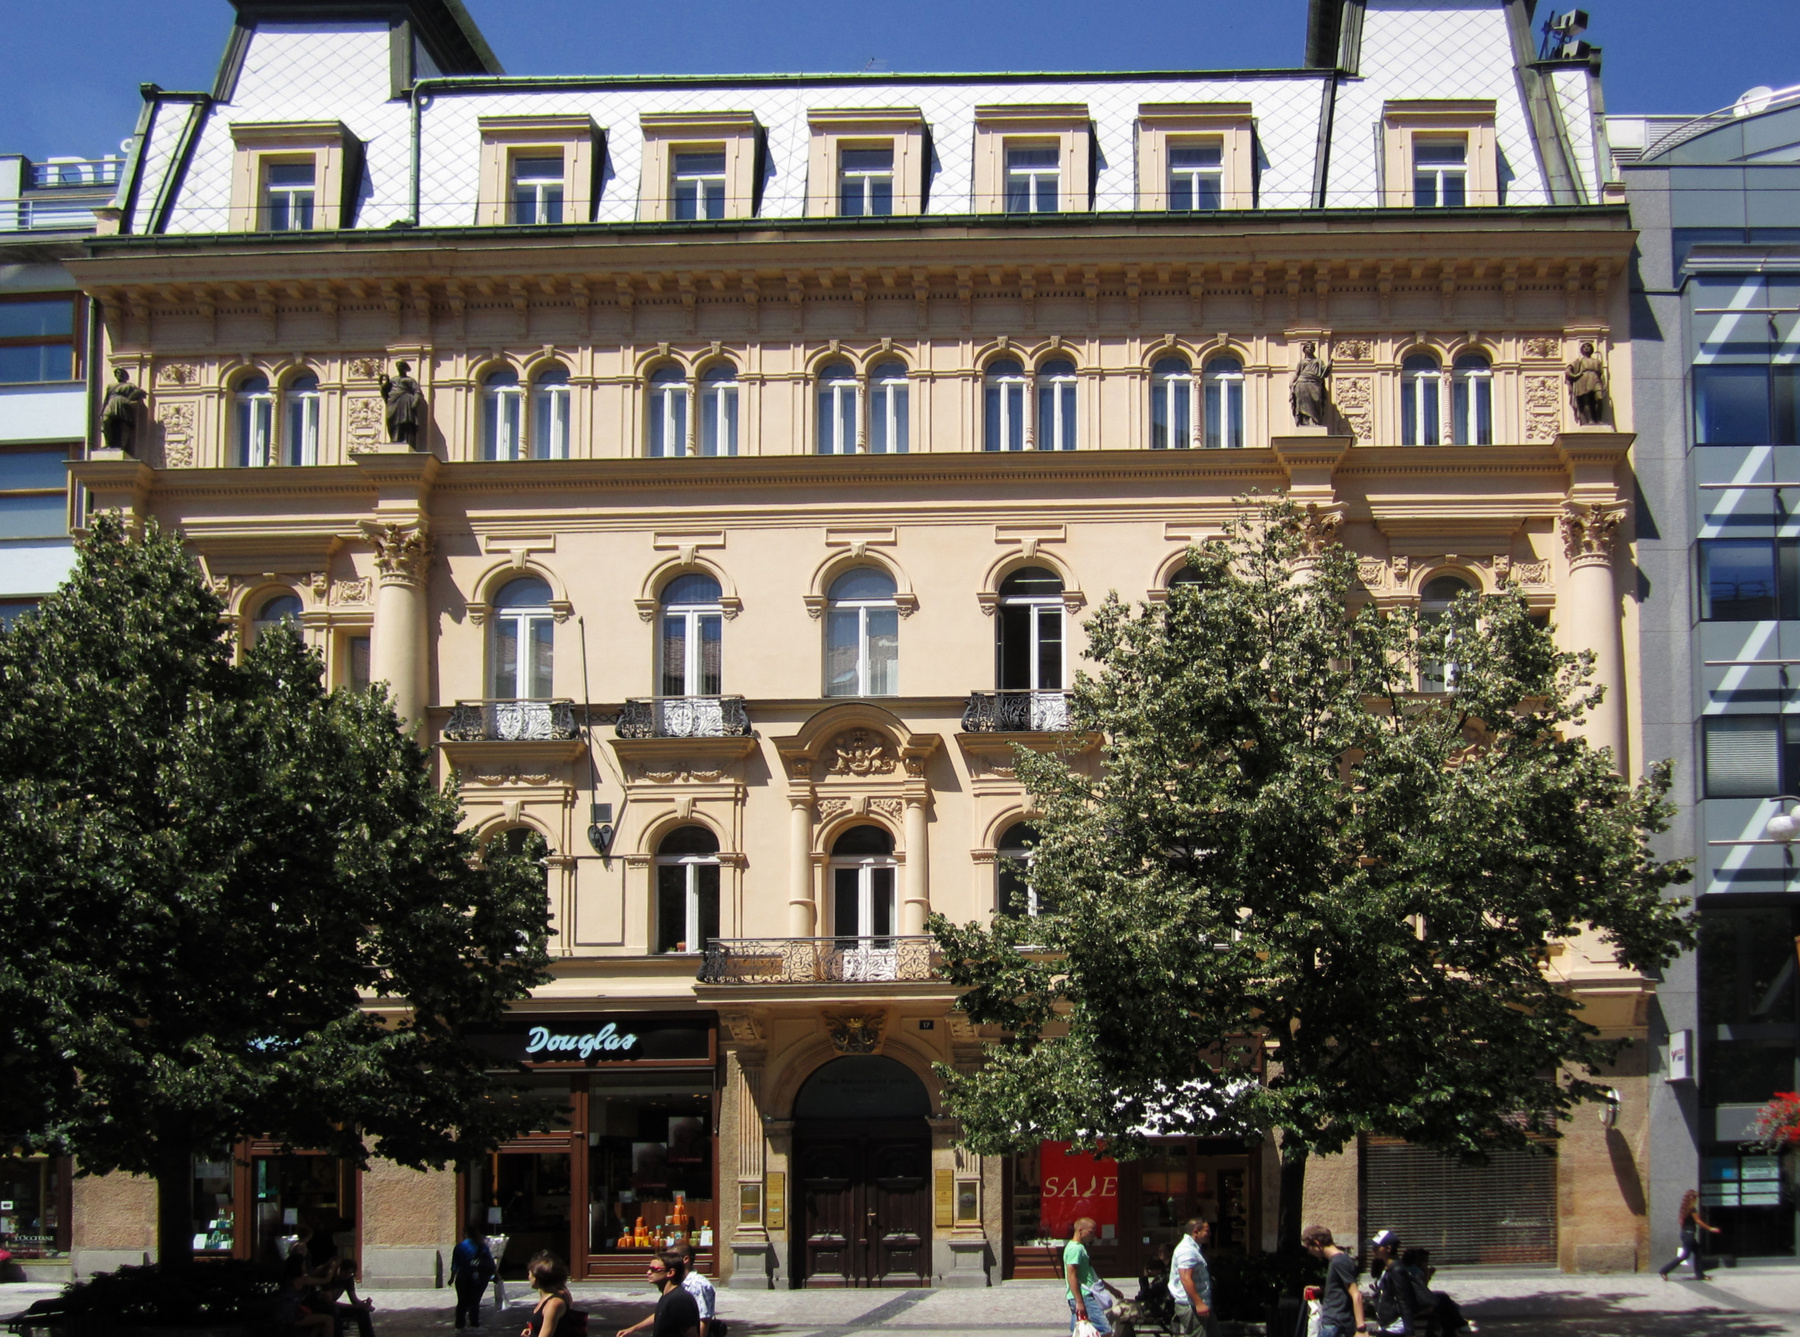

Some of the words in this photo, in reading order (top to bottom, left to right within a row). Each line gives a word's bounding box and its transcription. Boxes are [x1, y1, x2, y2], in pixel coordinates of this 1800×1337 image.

[923, 1021, 931, 1029] 17
[525, 1021, 639, 1059] Douglas
[1043, 1175, 1118, 1198] SALE
